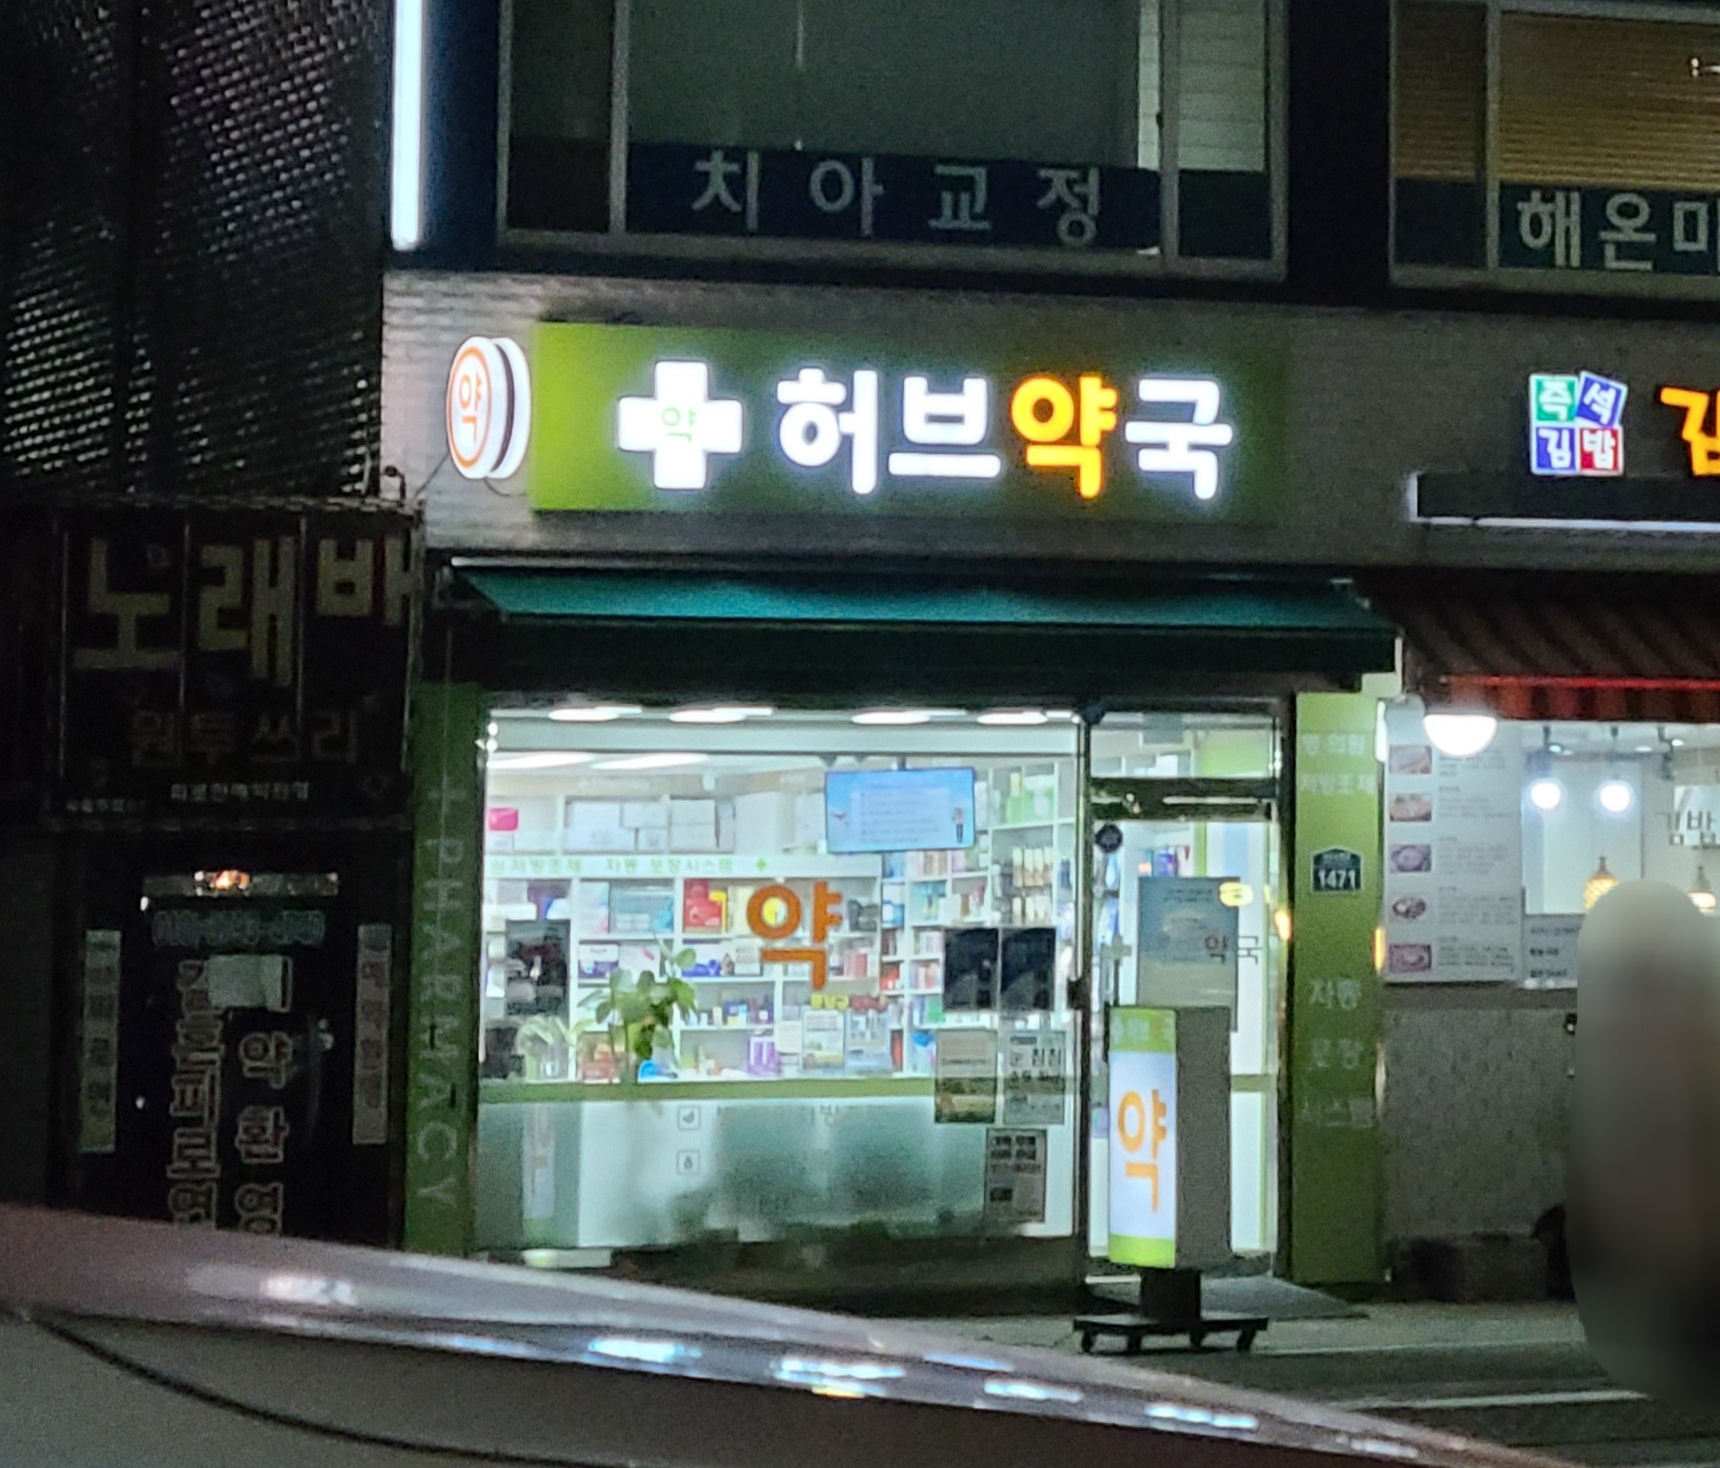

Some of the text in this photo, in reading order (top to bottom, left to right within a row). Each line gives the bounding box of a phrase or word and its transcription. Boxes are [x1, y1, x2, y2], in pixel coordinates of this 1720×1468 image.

[692, 149, 1103, 250] 치아교정
[777, 367, 1235, 500] 허브약국
[1537, 377, 1618, 426] 즉석
[1537, 427, 1618, 471] 김밥
[1317, 869, 1357, 889] 1471
[745, 881, 844, 991] 약
[1116, 1088, 1168, 1213] 약
